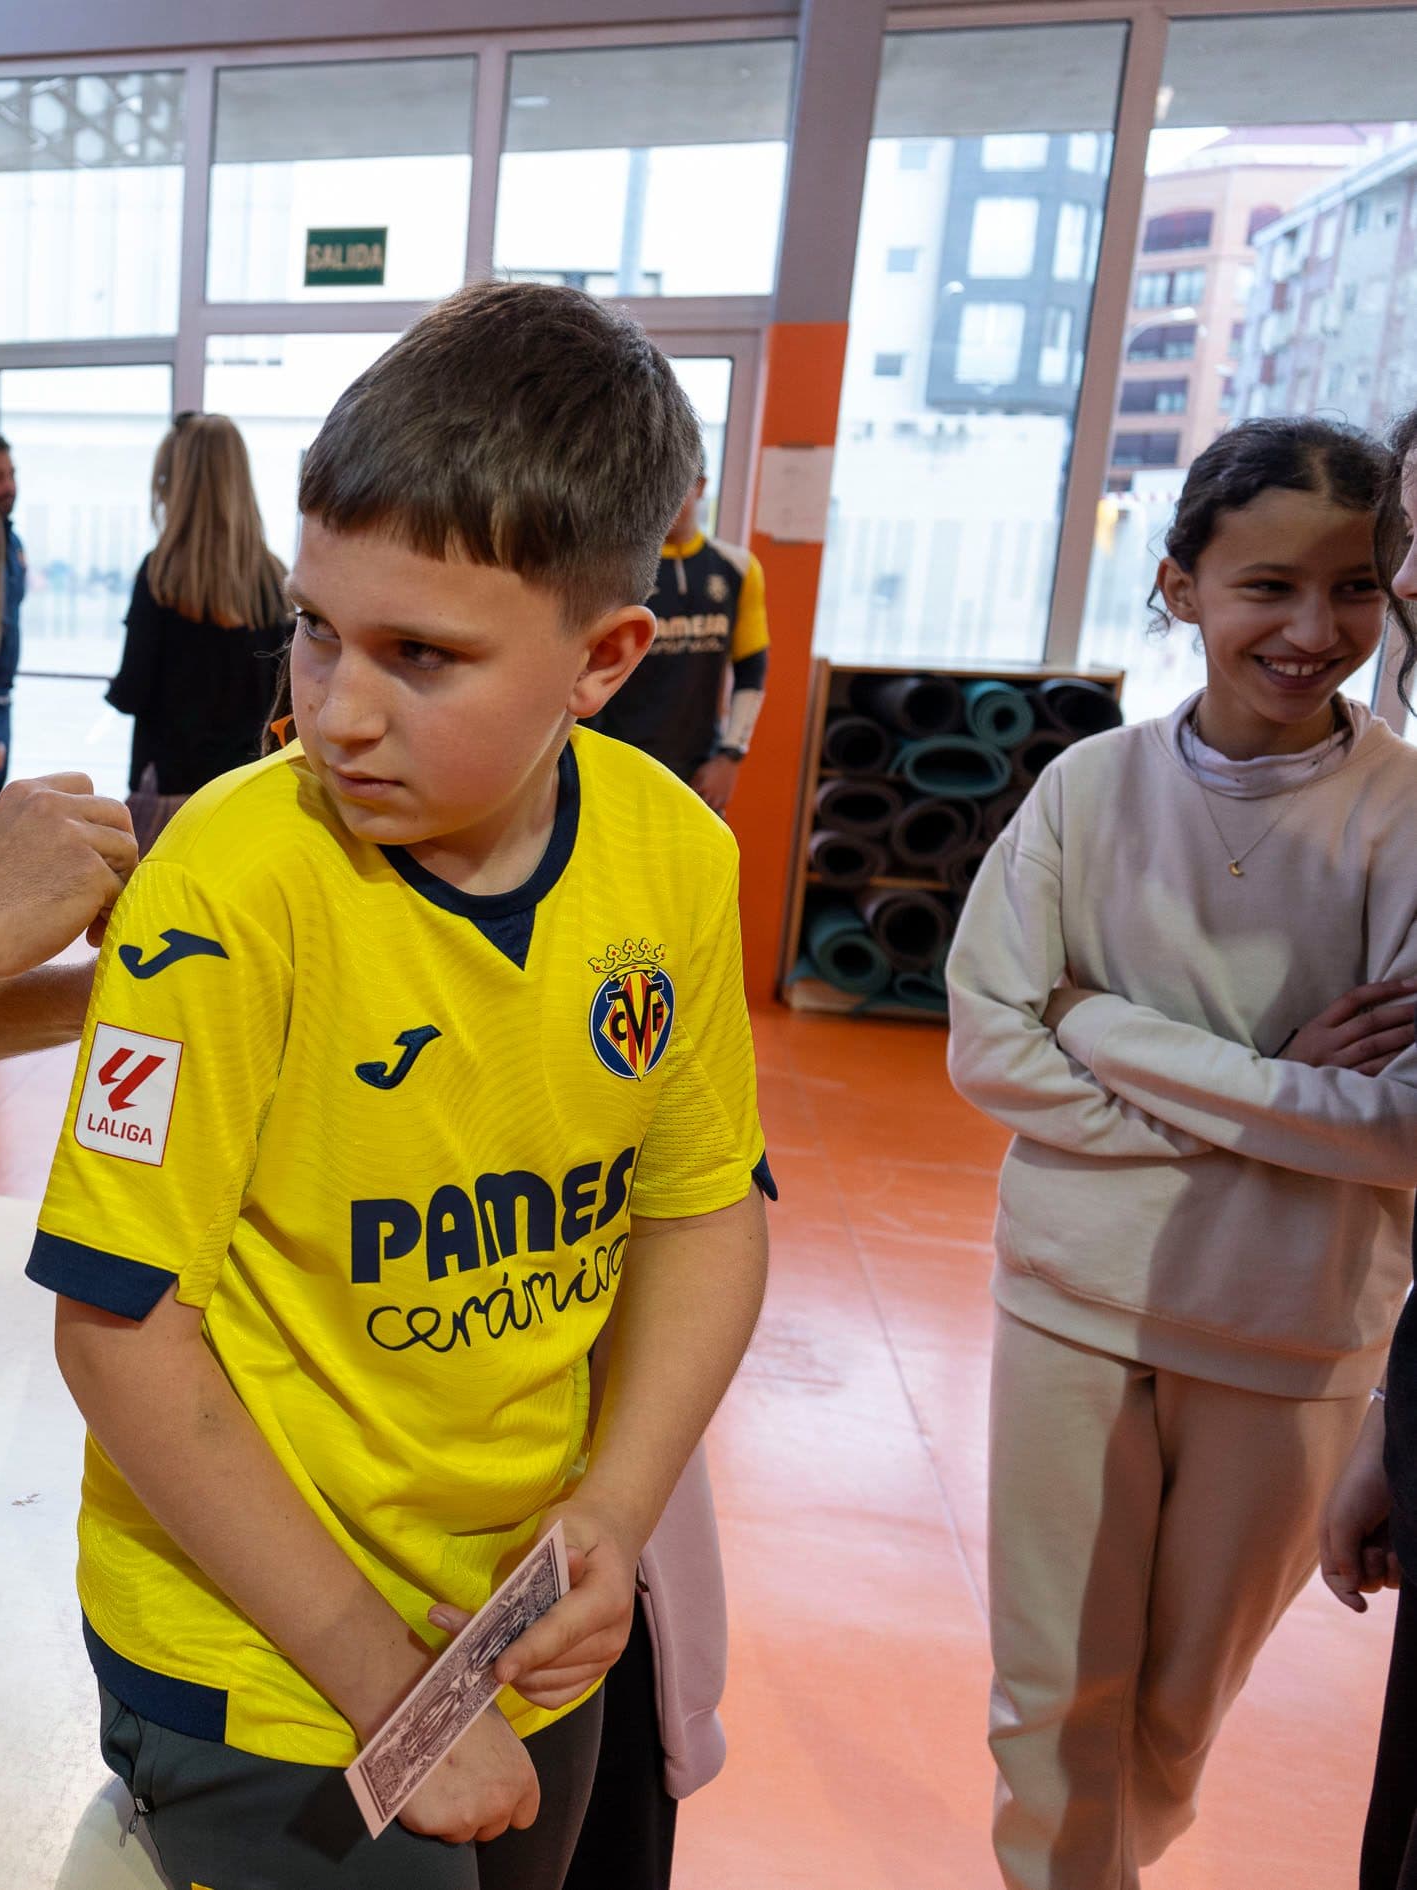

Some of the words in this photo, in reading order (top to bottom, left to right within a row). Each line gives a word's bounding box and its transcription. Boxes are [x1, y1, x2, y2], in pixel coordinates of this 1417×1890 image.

[306, 243, 382, 272] SALIDA
[87, 1112, 152, 1146] LALIGA
[350, 1146, 636, 1284] PAMES
